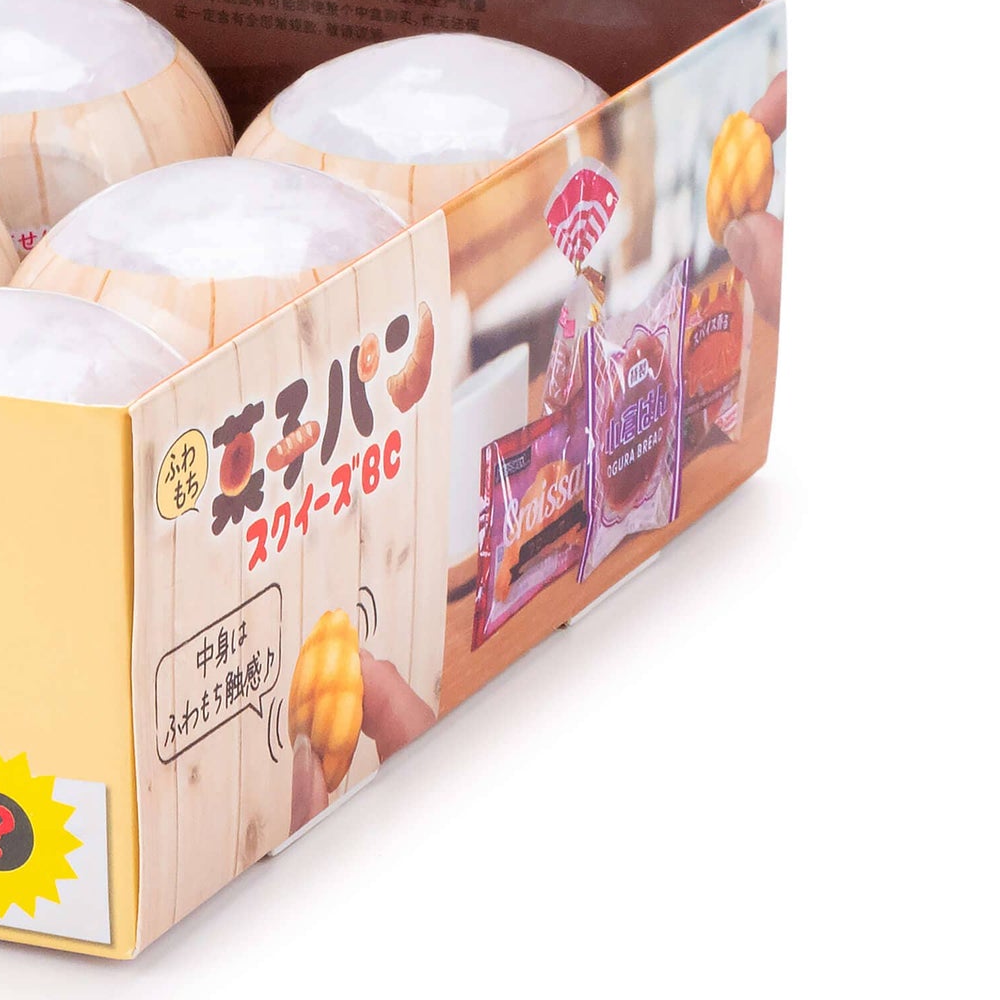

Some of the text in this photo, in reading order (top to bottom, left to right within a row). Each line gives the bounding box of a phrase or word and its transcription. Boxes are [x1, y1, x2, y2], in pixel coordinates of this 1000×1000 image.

[165, 443, 196, 483] ふわ
[606, 427, 664, 479] OGURA BREAD
[173, 471, 200, 510] もち
[196, 620, 248, 679] 中身は
